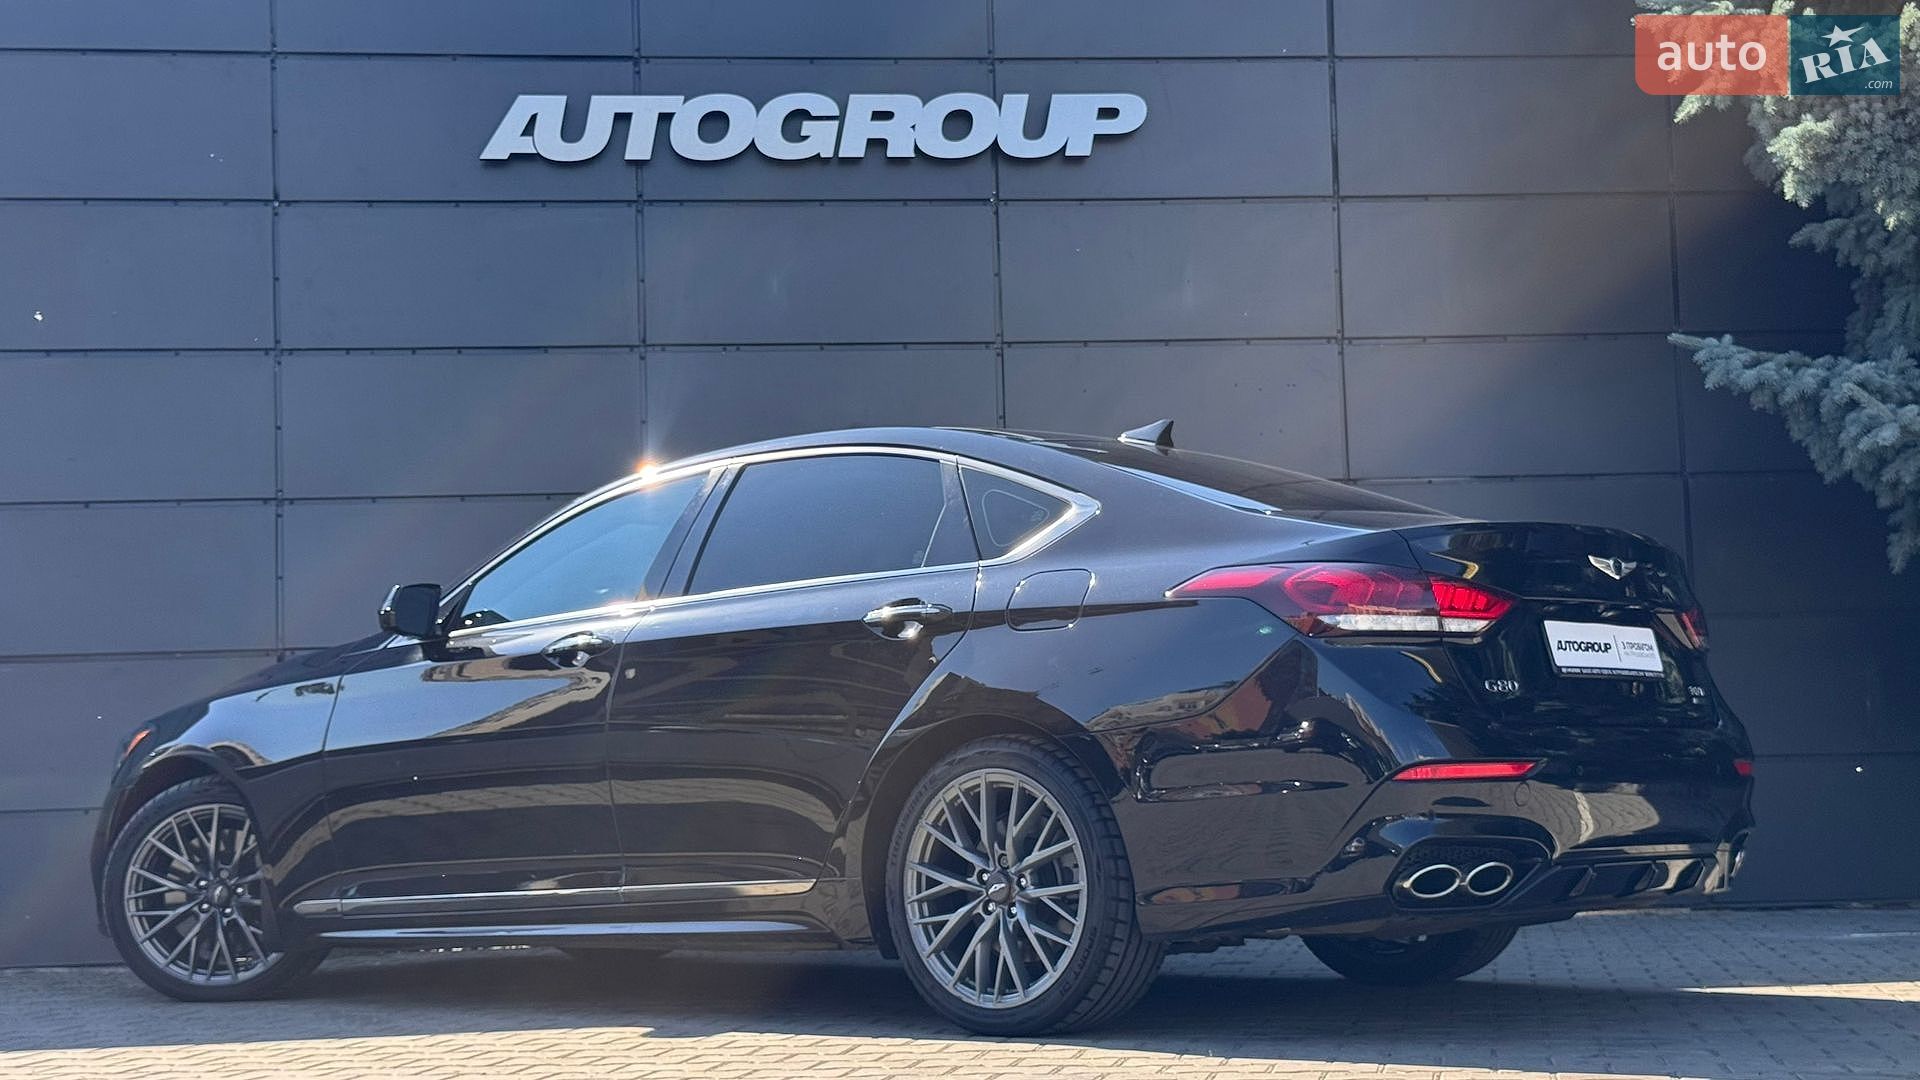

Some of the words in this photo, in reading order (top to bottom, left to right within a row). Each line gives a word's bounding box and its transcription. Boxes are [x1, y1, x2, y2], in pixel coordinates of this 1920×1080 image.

[479, 92, 1148, 162] AUTOGROUP
[1556, 640, 1612, 654] AUTOGROUP
[1484, 679, 1520, 692] G80
